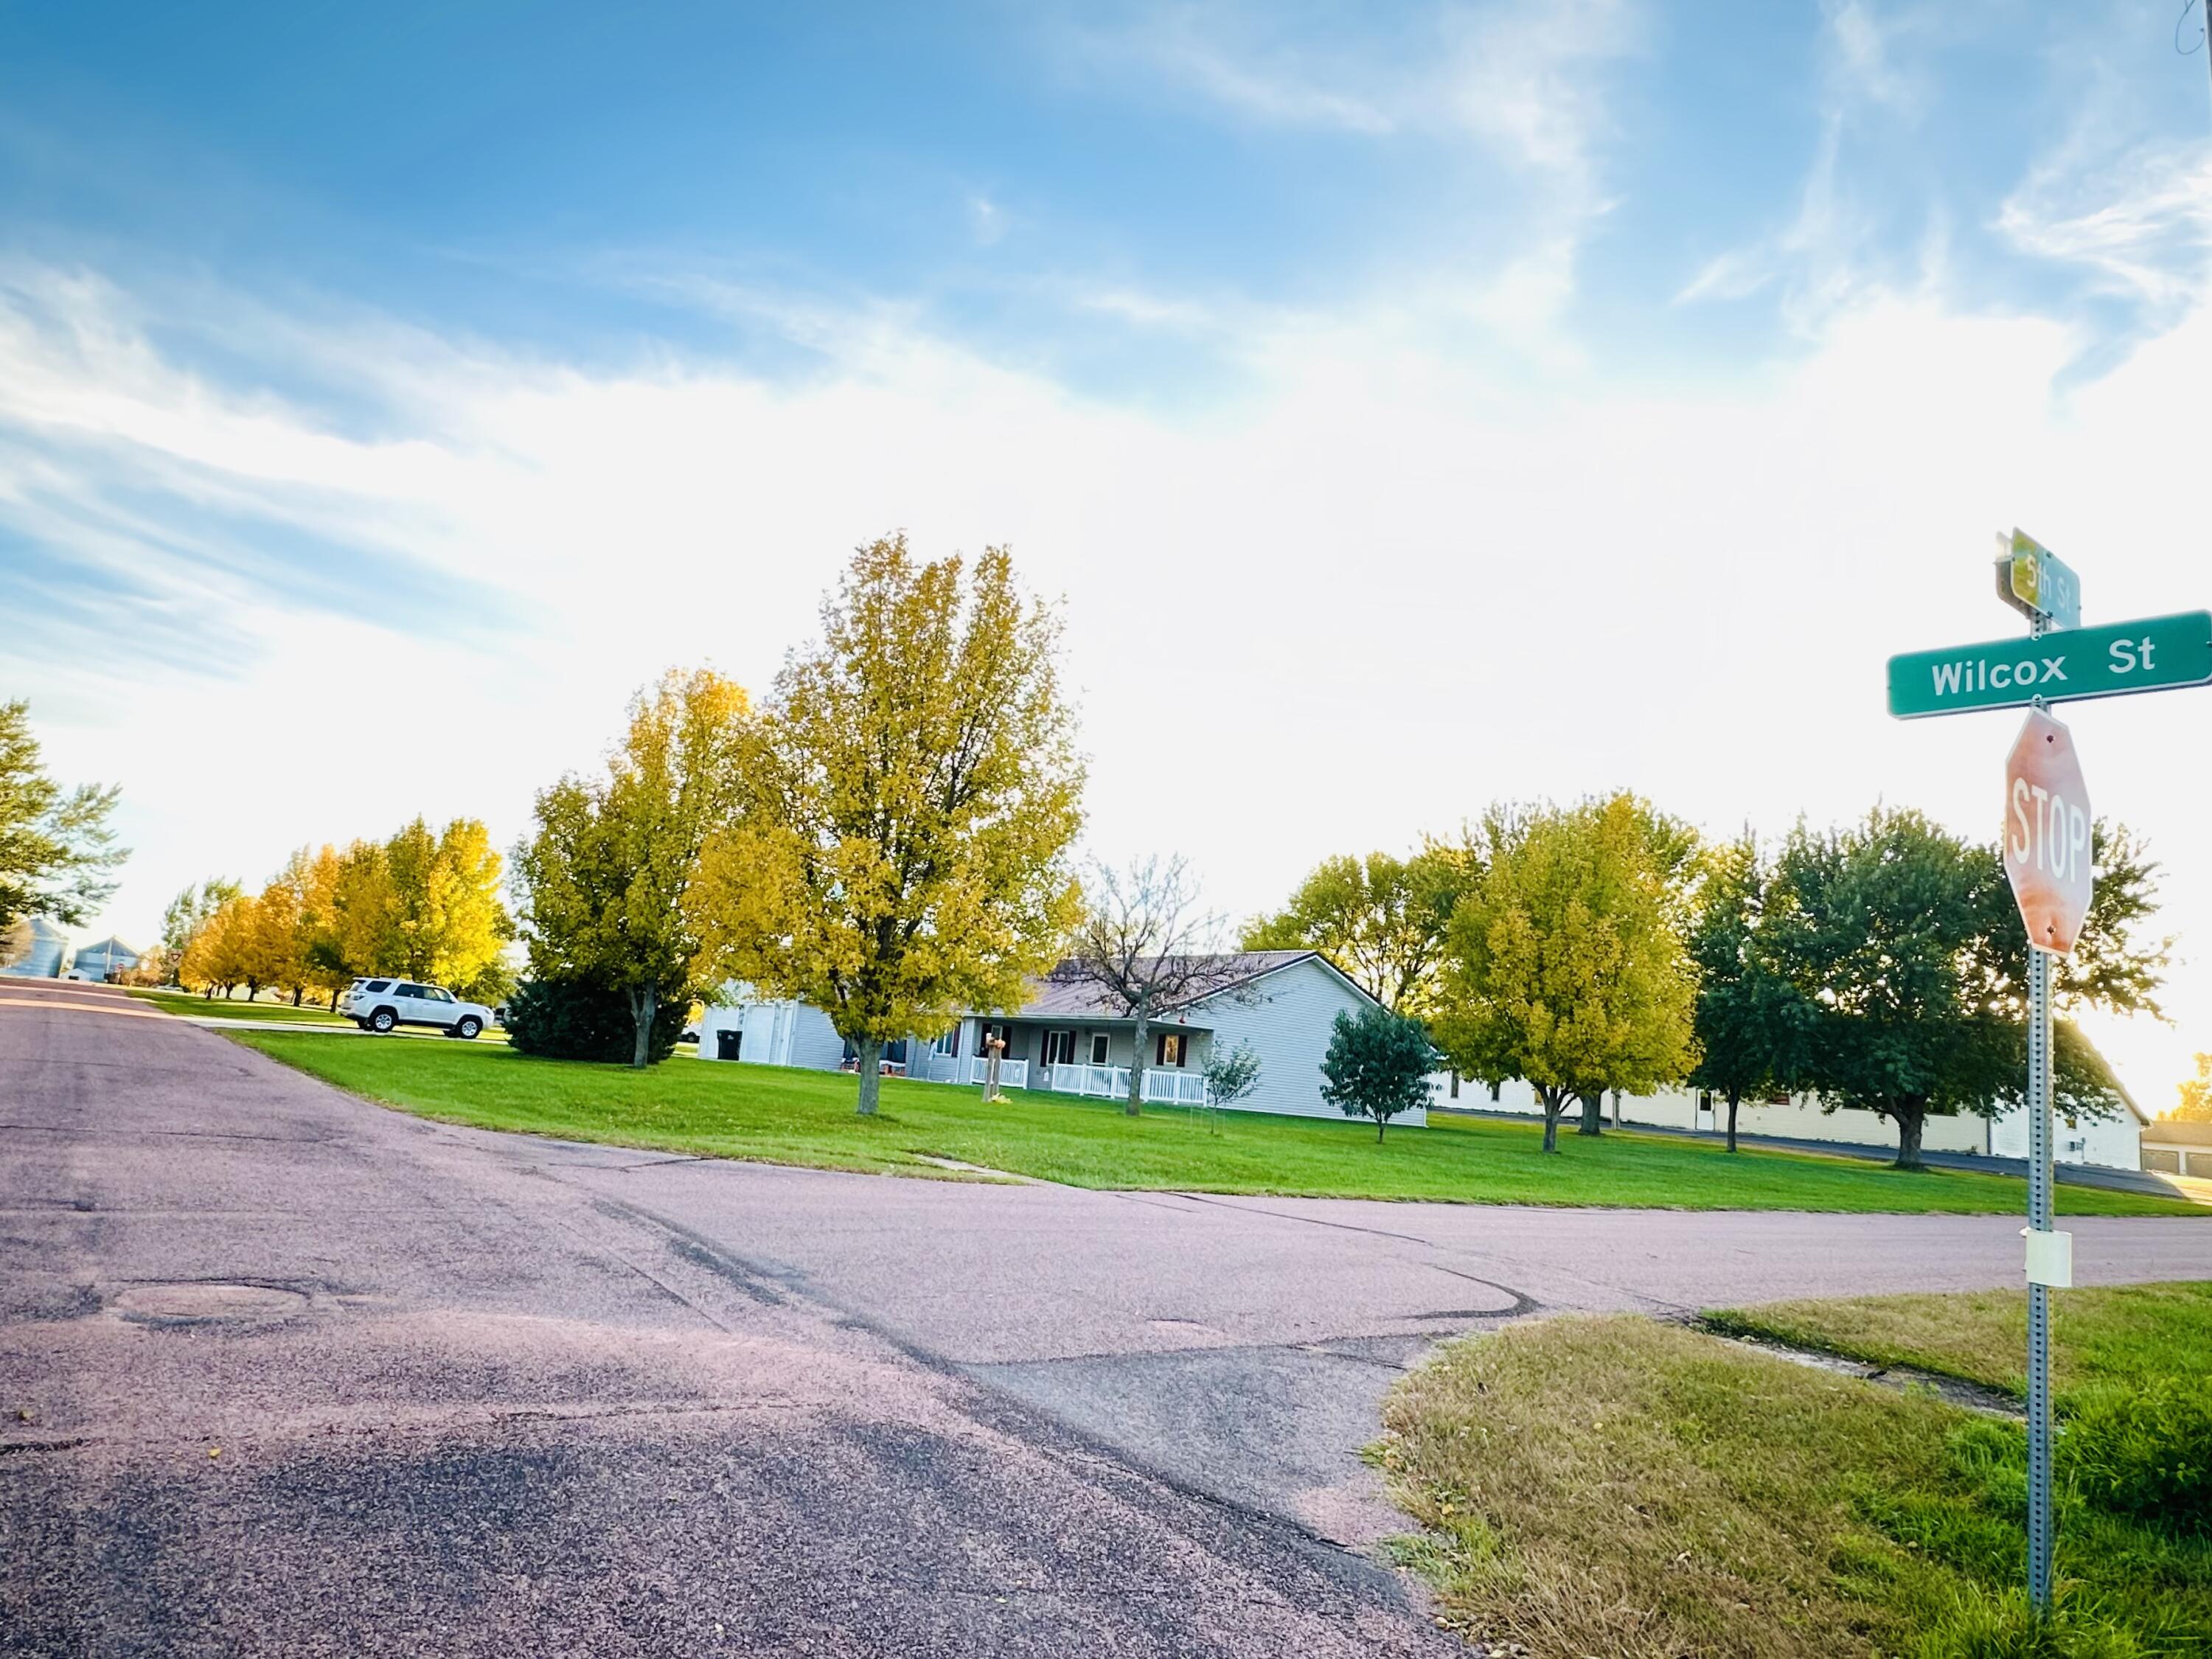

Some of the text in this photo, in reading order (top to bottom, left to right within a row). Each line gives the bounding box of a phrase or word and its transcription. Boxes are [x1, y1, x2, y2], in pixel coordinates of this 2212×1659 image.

[2025, 554, 2071, 613] 5th St
[1932, 636, 2155, 696] Wilcox St
[2011, 777, 2086, 883] STOP
